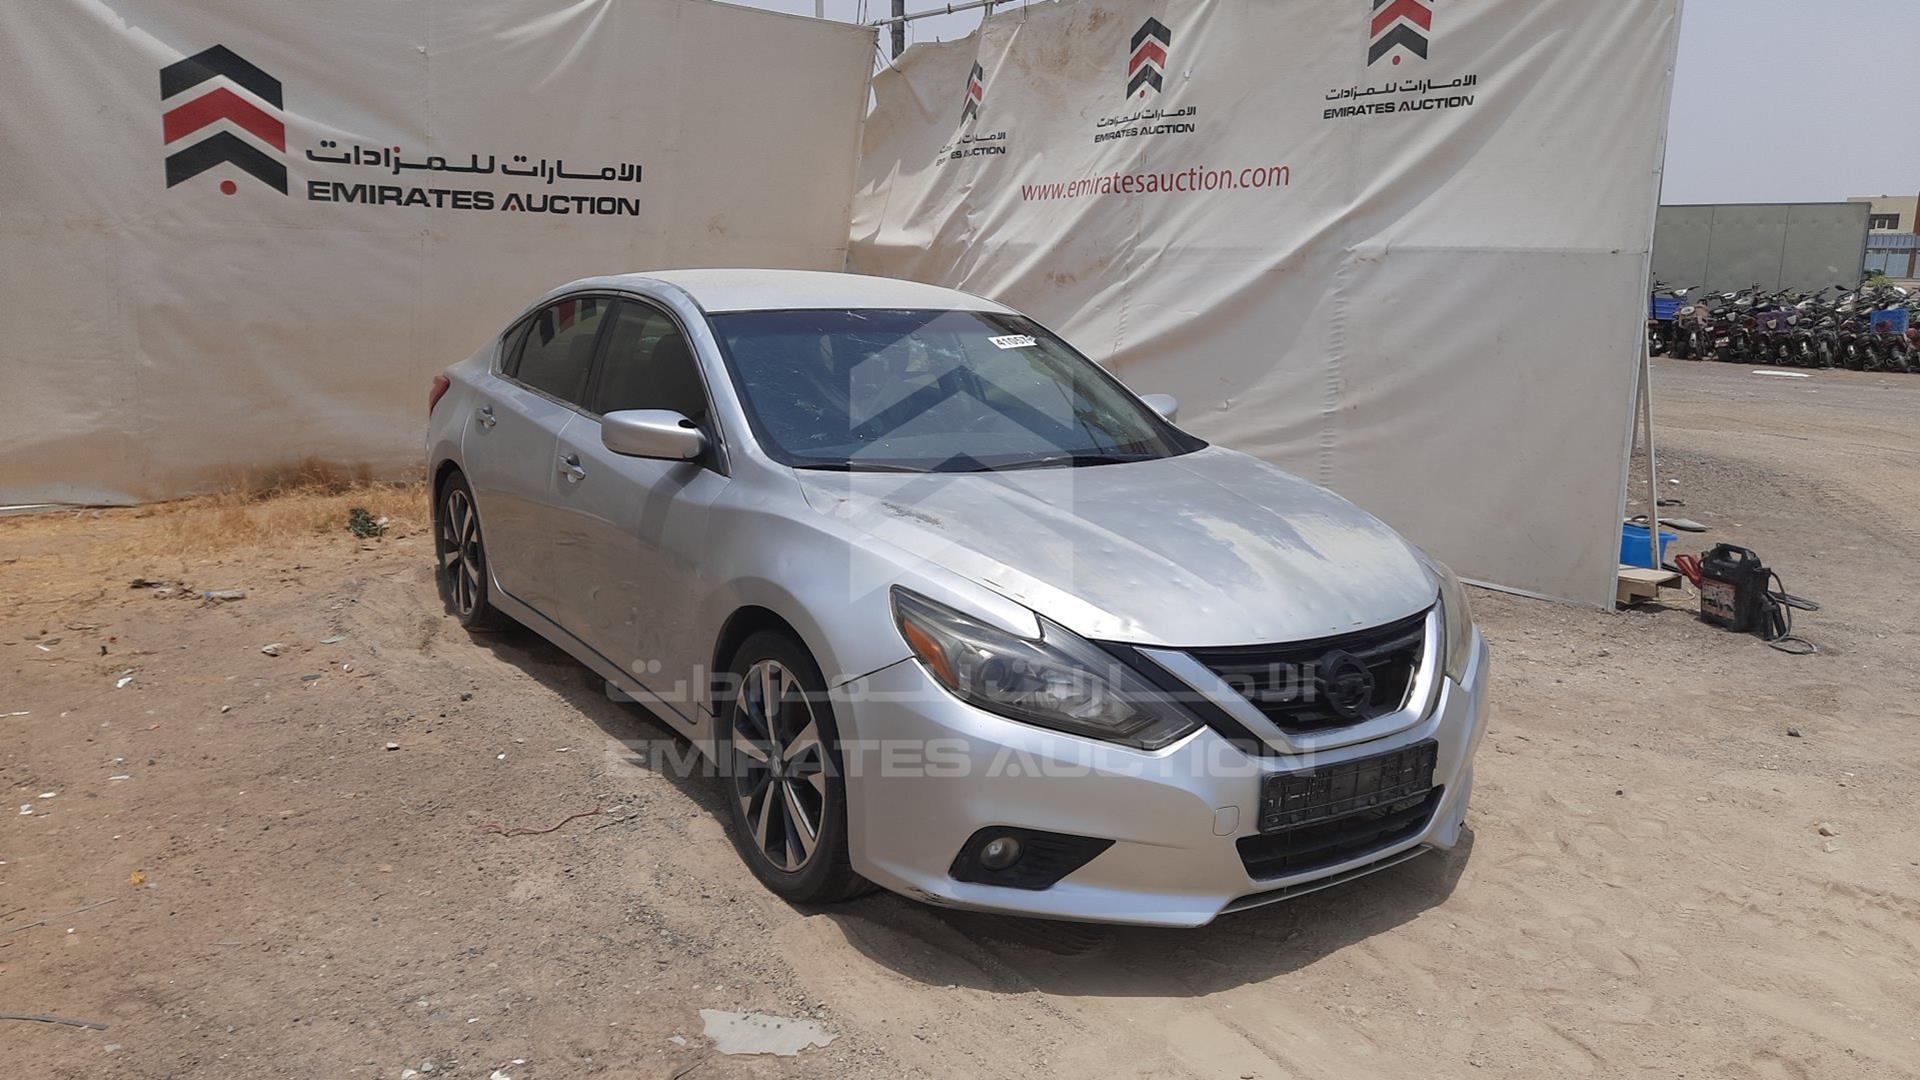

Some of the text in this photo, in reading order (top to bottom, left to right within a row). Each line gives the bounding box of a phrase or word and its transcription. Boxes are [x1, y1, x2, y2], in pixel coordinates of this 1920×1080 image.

[1323, 95, 1474, 119] EMIRATES AUCTION
[1094, 123, 1195, 143] EMIRATES AUCTION
[306, 180, 641, 216] EMIRATES AUCTION
[1021, 165, 1290, 201] www.emiratesauction.com
